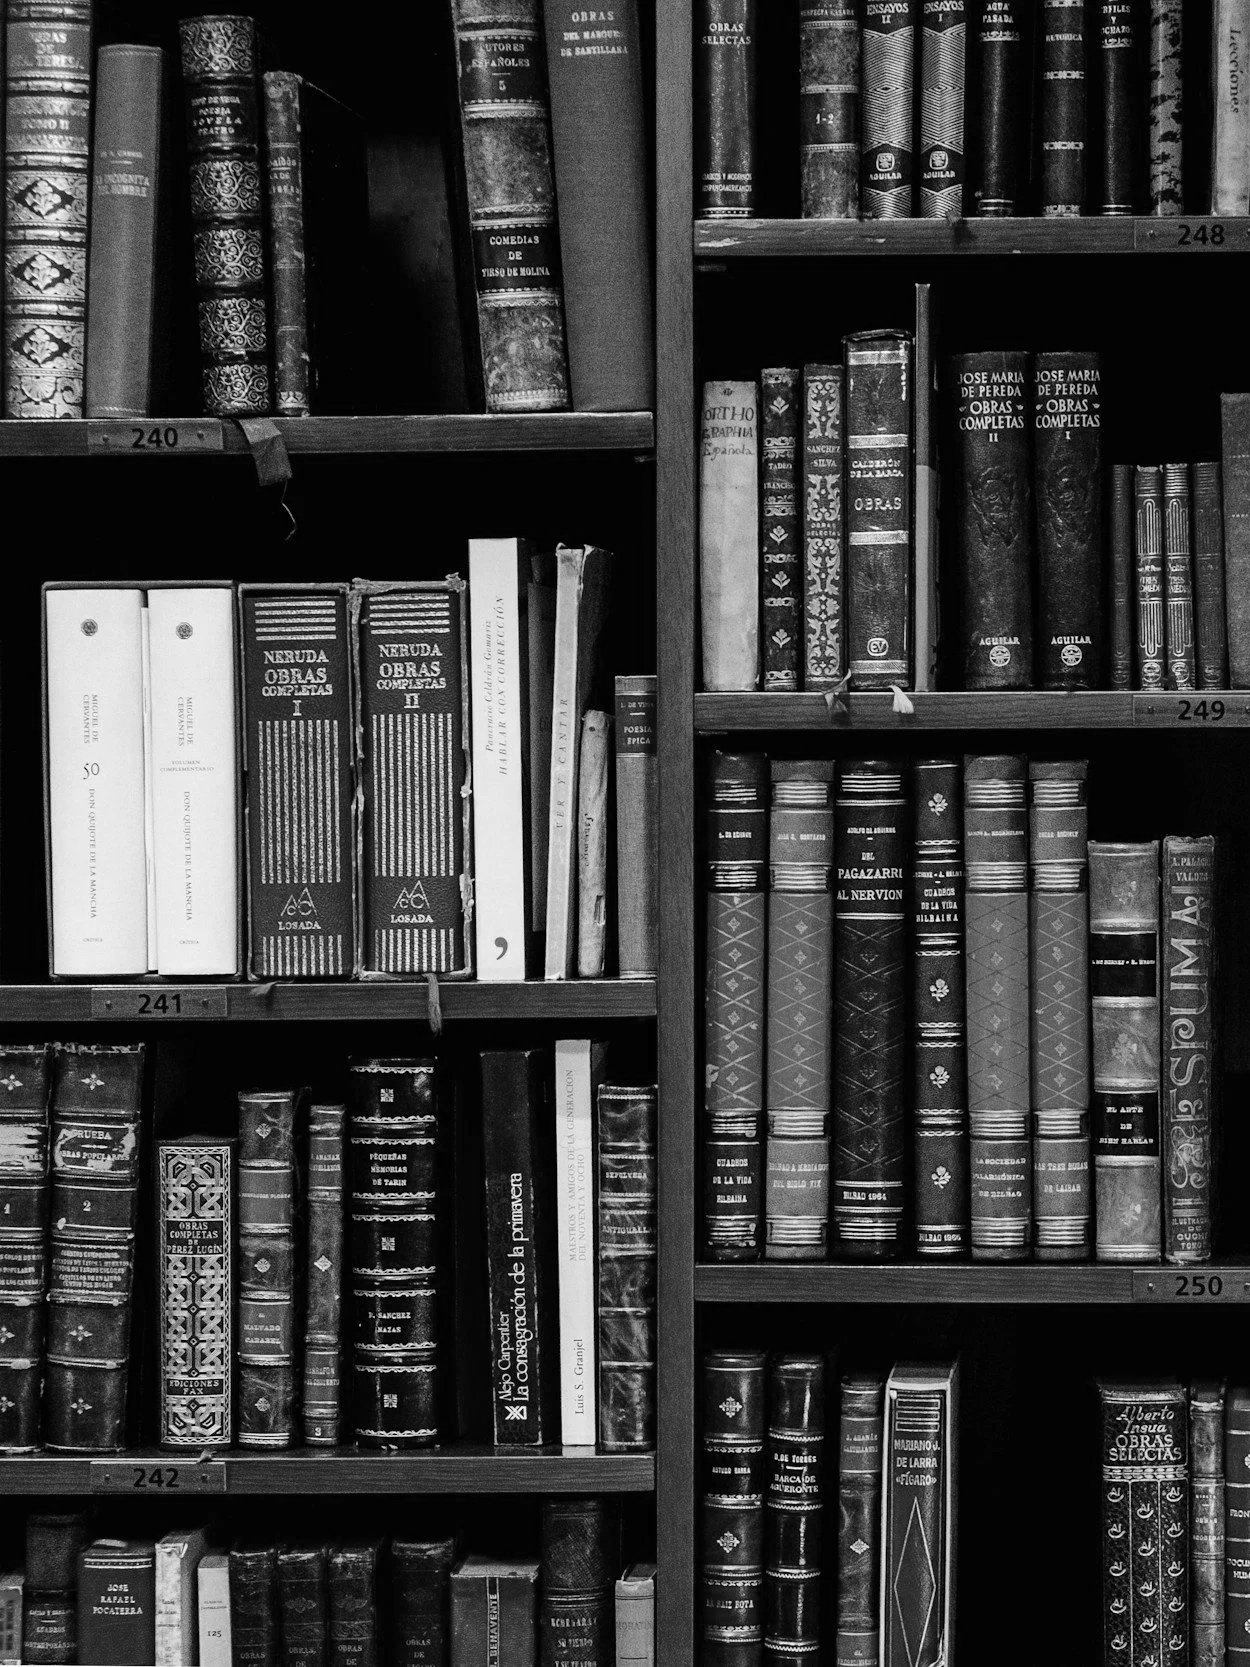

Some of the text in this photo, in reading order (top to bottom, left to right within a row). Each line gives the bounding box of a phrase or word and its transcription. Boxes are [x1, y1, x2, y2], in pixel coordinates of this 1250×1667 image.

[572, 11, 614, 22] OBRAS
[868, 2, 909, 24] ENSAYOS II
[709, 22, 744, 32] OBRAS
[702, 35, 751, 44] SELECTAS
[1229, 28, 1241, 113] Lecciones
[489, 236, 540, 246] COMEDIAS
[1177, 224, 1225, 246] 248
[508, 251, 523, 261] DE
[957, 371, 1025, 386] JOSE MARIA
[1034, 369, 1101, 384] JOSE MARIA
[961, 384, 1022, 398] DE PEREDA
[1037, 383, 1098, 397] DE PEREDA
[970, 400, 1013, 415] OBRAS
[1046, 399, 1088, 413] OBRAS
[705, 406, 755, 422] ORTHO
[959, 416, 1025, 431] COMPLETAS
[1035, 414, 1101, 429] COMPLETAS
[131, 427, 179, 448] 240
[806, 445, 841, 454] SANCHEZ
[768, 462, 793, 471] TADEO
[854, 497, 902, 511] OBRAS
[980, 636, 1020, 645] AGUILAR
[1051, 635, 1092, 645] AGUILAR
[263, 649, 329, 664] NERUDA
[378, 643, 443, 659] NERUDA
[264, 667, 328, 684] OBRAS
[379, 661, 442, 679] OBRAS
[261, 683, 334, 697] COMPLETAS
[376, 677, 448, 691] COMPLETAS
[495, 596, 508, 776] HABLAR CON CORRECCIÓN
[292, 699, 302, 716] I
[403, 692, 421, 710] II
[1177, 699, 1226, 721] 249
[624, 725, 653, 734] POESIA
[626, 737, 651, 746] EPICA
[838, 868, 903, 879] PAGAZARRI
[837, 889, 903, 901] AL NERVION
[278, 920, 322, 931] LOSADA
[390, 914, 434, 924] LOSADA
[916, 914, 959, 923] BILBAINA
[138, 993, 182, 1014] 241
[1119, 1123, 1133, 1131] DE
[369, 1152, 408, 1161] PEQUEÑAS
[716, 1158, 748, 1167] CUADROS
[370, 1166, 408, 1174] MEMORIAS
[83, 1200, 92, 1212] 2
[178, 1221, 209, 1230] OBRAS
[169, 1230, 219, 1239] COMPLETAS
[506, 1171, 534, 1403] la consagración de la primavera
[1175, 1275, 1223, 1297] 250
[496, 1311, 516, 1402] Alejo Carpentier
[169, 1380, 220, 1388] EDICIONES
[1115, 1404, 1175, 1423] Alberto
[1115, 1434, 1174, 1448] OBRAS
[1108, 1447, 1183, 1462] SELECTAS
[896, 1457, 938, 1468] DE LARRA
[133, 1468, 179, 1488] 242
[774, 1474, 816, 1484] BARCA DE
[107, 1583, 129, 1593] JOSE
[100, 1595, 135, 1604] RAFAEL
[93, 1606, 143, 1616] POCATERRA
[488, 1593, 497, 1661] BENAVENTE
